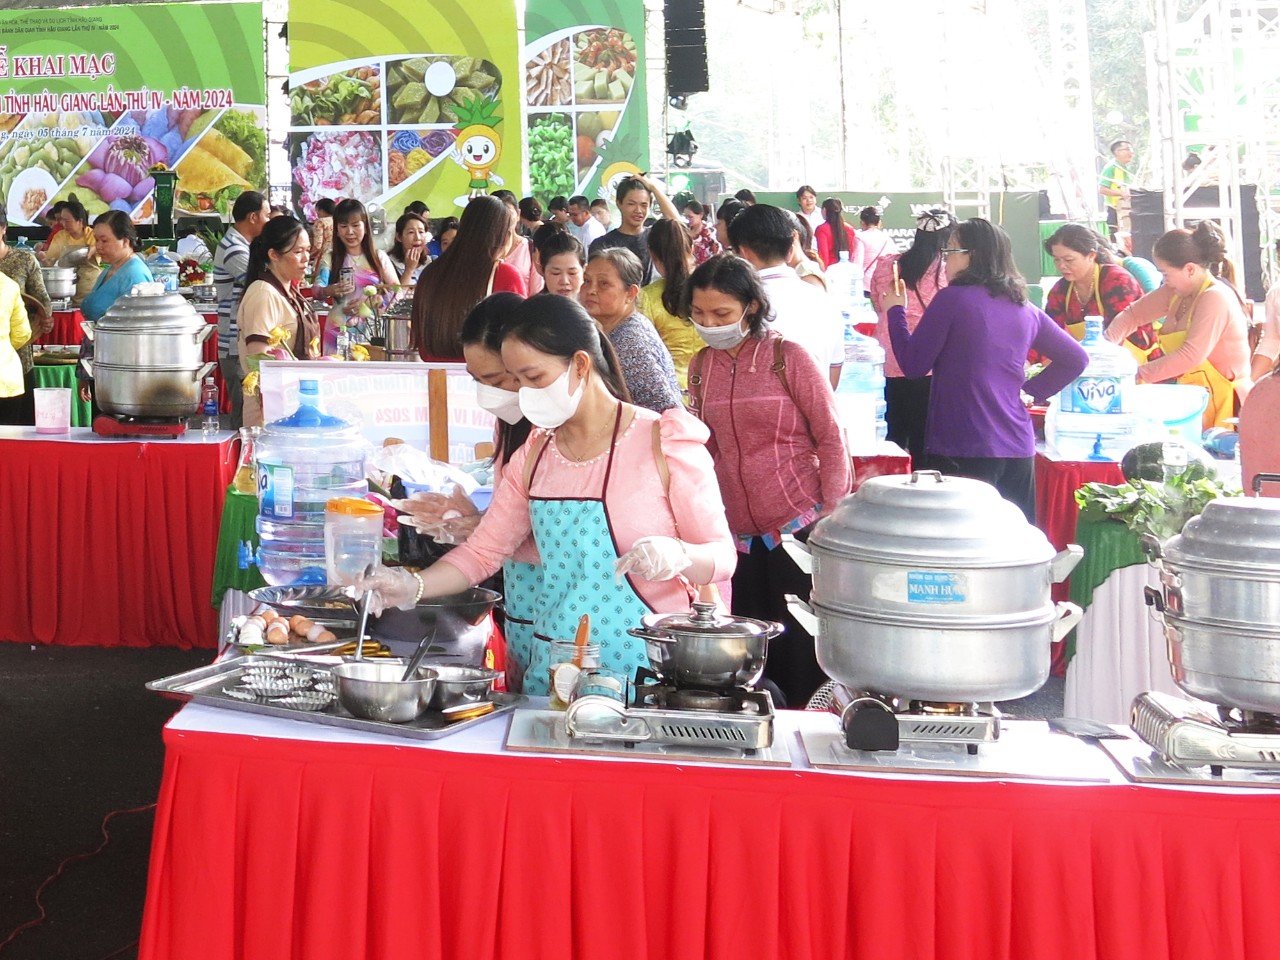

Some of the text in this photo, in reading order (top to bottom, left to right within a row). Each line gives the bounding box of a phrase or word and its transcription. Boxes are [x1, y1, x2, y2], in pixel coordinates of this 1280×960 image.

[13, 54, 65, 78] KHAI
[69, 53, 114, 80] MẠC
[4, 89, 30, 113] TỈNH
[34, 89, 58, 116] HẬU
[61, 92, 97, 112] GIANG
[100, 85, 123, 111] LẦN
[125, 86, 149, 111] THỨ
[151, 91, 162, 110] IV
[173, 86, 201, 109] NĂM
[205, 90, 233, 108] 2024
[12, 128, 35, 142] ngày
[37, 127, 49, 138] 05
[51, 126, 79, 139] tháng
[82, 126, 88, 136] 7
[90, 126, 112, 136] năm
[114, 125, 136, 136] 2024
